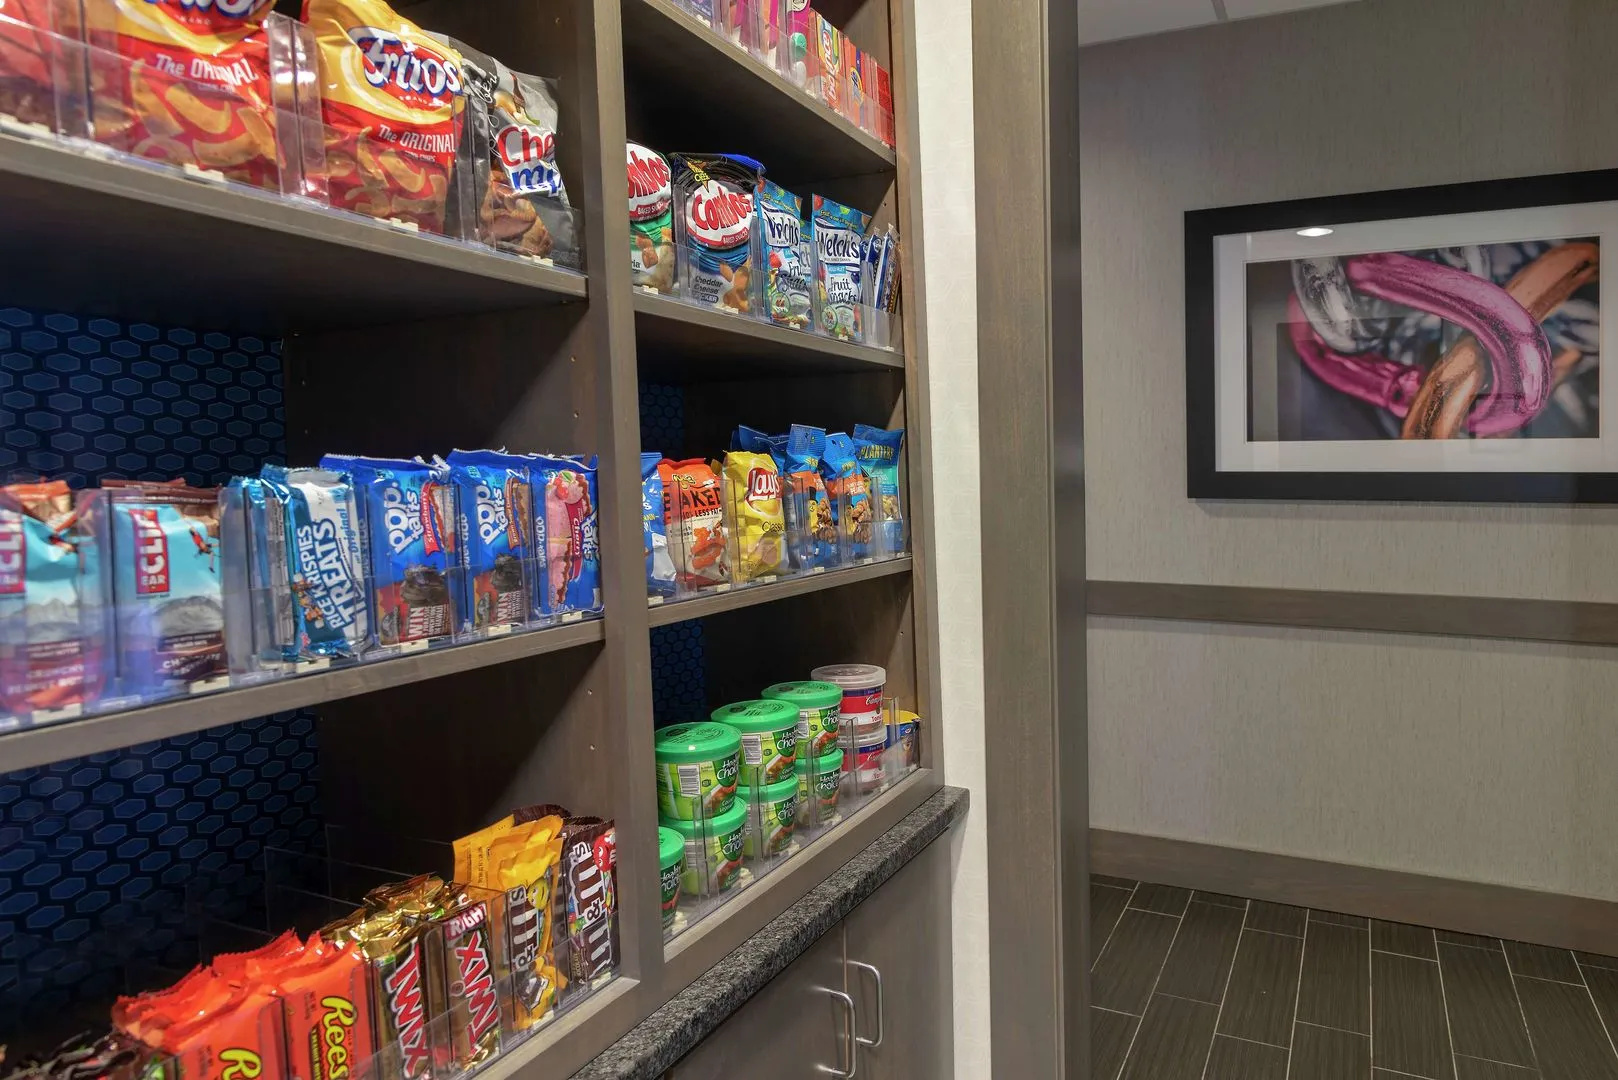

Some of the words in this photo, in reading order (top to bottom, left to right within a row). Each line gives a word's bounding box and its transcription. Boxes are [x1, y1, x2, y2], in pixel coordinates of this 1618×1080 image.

[156, 53, 185, 76] The
[347, 26, 463, 95] Fritos
[379, 124, 398, 143] The
[400, 131, 456, 153] ORIGINAL
[498, 126, 555, 167] Che
[692, 186, 752, 231] Combos
[815, 228, 860, 259] Welch's
[748, 469, 780, 501] Lay's
[695, 508, 710, 518] LESS
[134, 512, 164, 574] CLIF
[297, 525, 324, 597] KRISPIES
[142, 575, 166, 586] BAR
[313, 518, 366, 624] TREATS
[316, 599, 344, 629] RICE
[408, 606, 425, 639] WIN
[449, 903, 487, 940] RIGHT
[386, 936, 432, 1078] TWIX
[455, 930, 501, 1058] TWIX
[321, 996, 359, 1080] Rees
